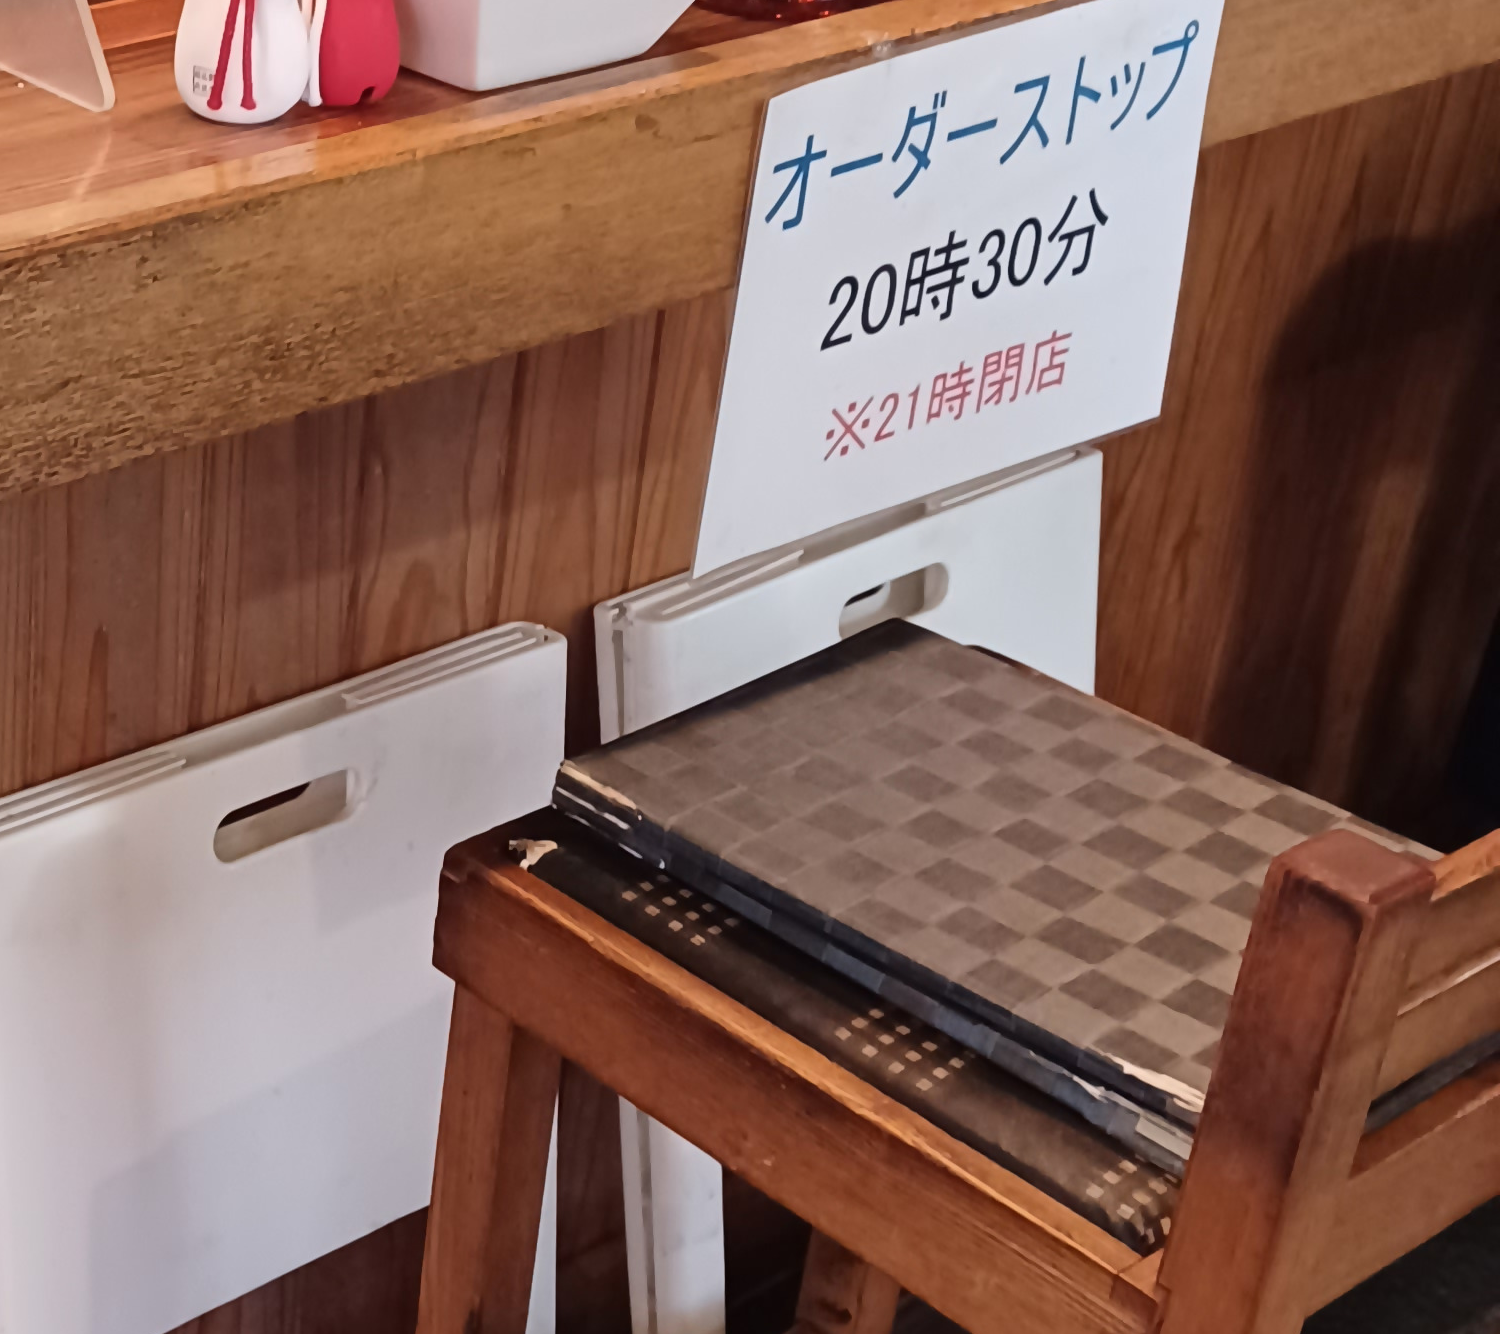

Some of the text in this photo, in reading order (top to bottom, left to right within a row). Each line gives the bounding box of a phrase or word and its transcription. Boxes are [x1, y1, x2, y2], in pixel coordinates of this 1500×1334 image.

[764, 19, 1201, 232] オーダーストップ
[819, 188, 1110, 352] 20時30分
